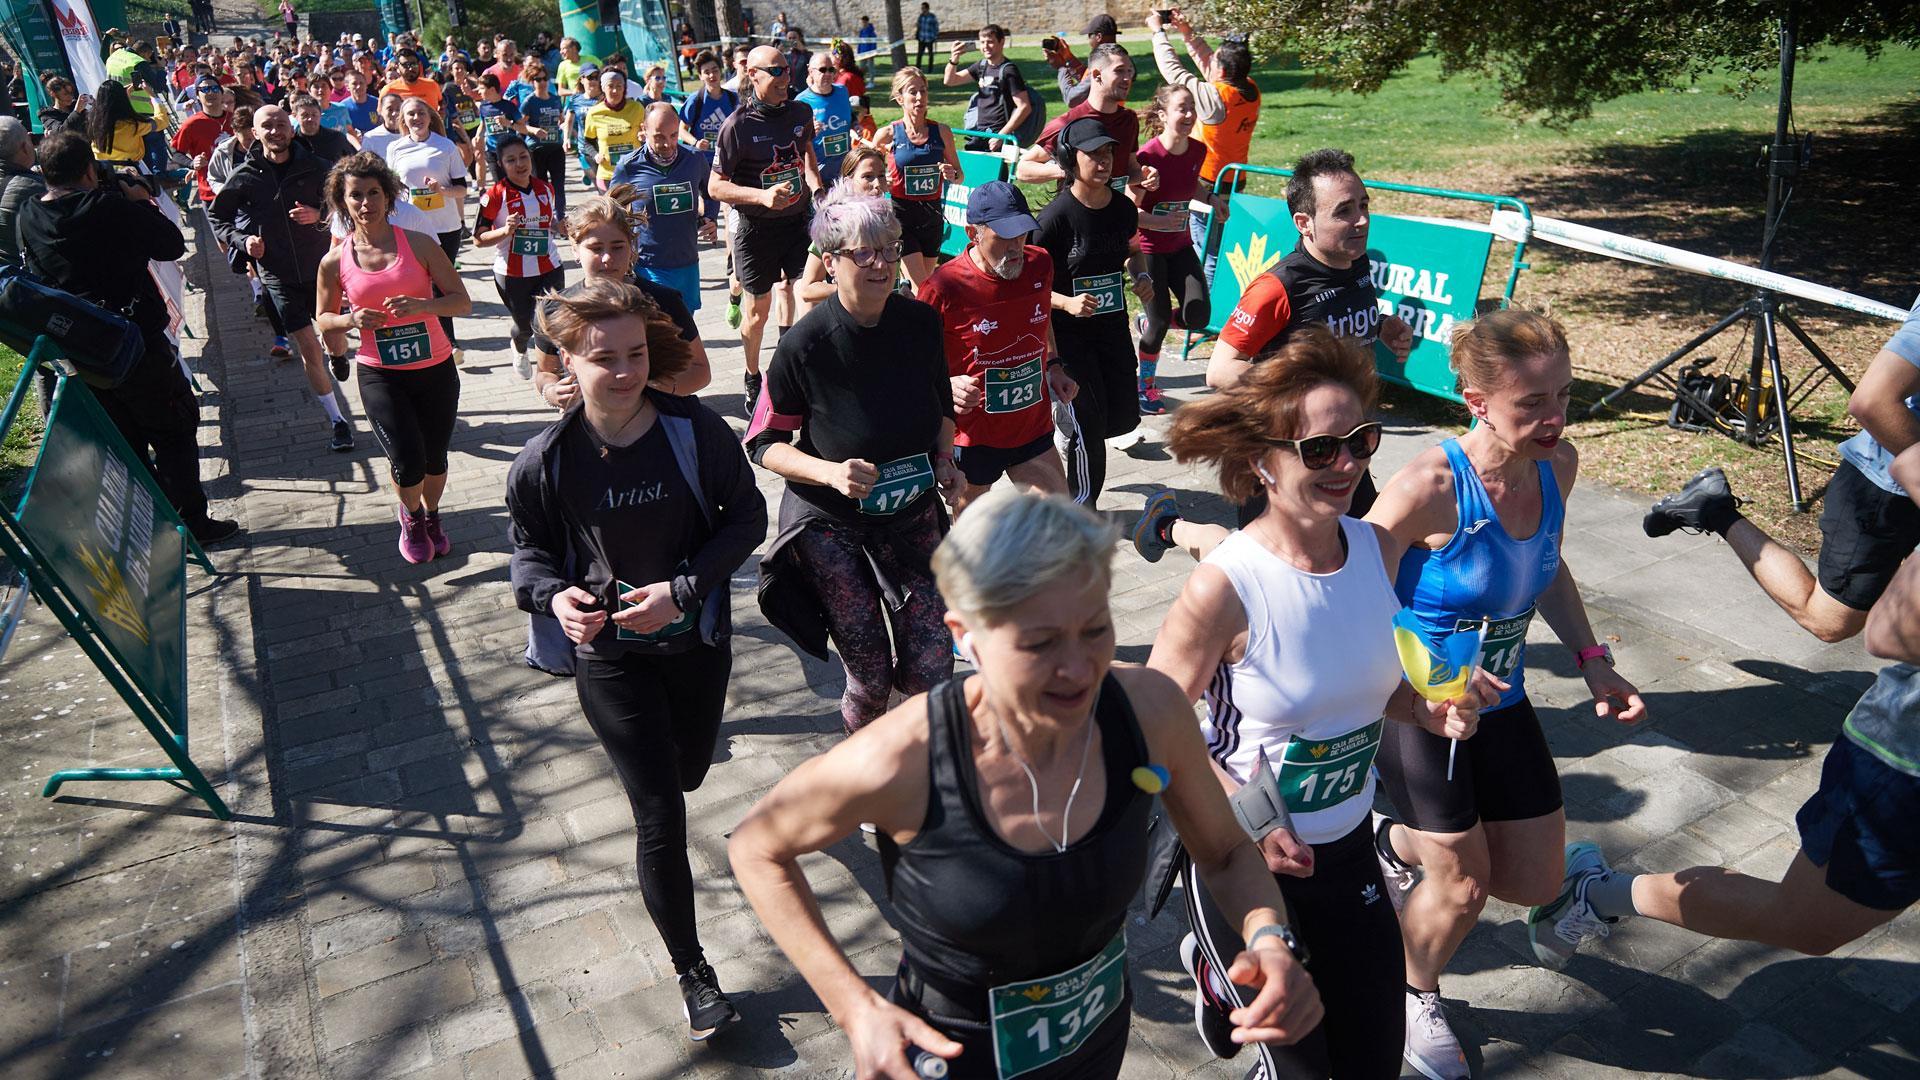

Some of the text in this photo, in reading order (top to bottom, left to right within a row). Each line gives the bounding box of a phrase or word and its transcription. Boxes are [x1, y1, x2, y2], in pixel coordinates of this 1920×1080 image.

[834, 144, 841, 152] 3
[912, 178, 934, 191] 143
[424, 197, 432, 207] 7
[671, 197, 680, 210] 2
[523, 240, 539, 253] 31
[1369, 259, 1453, 306] RURAL
[1096, 291, 1115, 308] 92
[388, 341, 421, 361] 151
[998, 383, 1034, 406] 123
[596, 481, 669, 509] Artist.
[876, 484, 919, 512] 174
[1330, 748, 1340, 757] DE
[1331, 740, 1347, 750] CAJA
[1299, 761, 1360, 802] 175
[1055, 976, 1079, 990] CAJA
[1027, 984, 1105, 1053] 132
